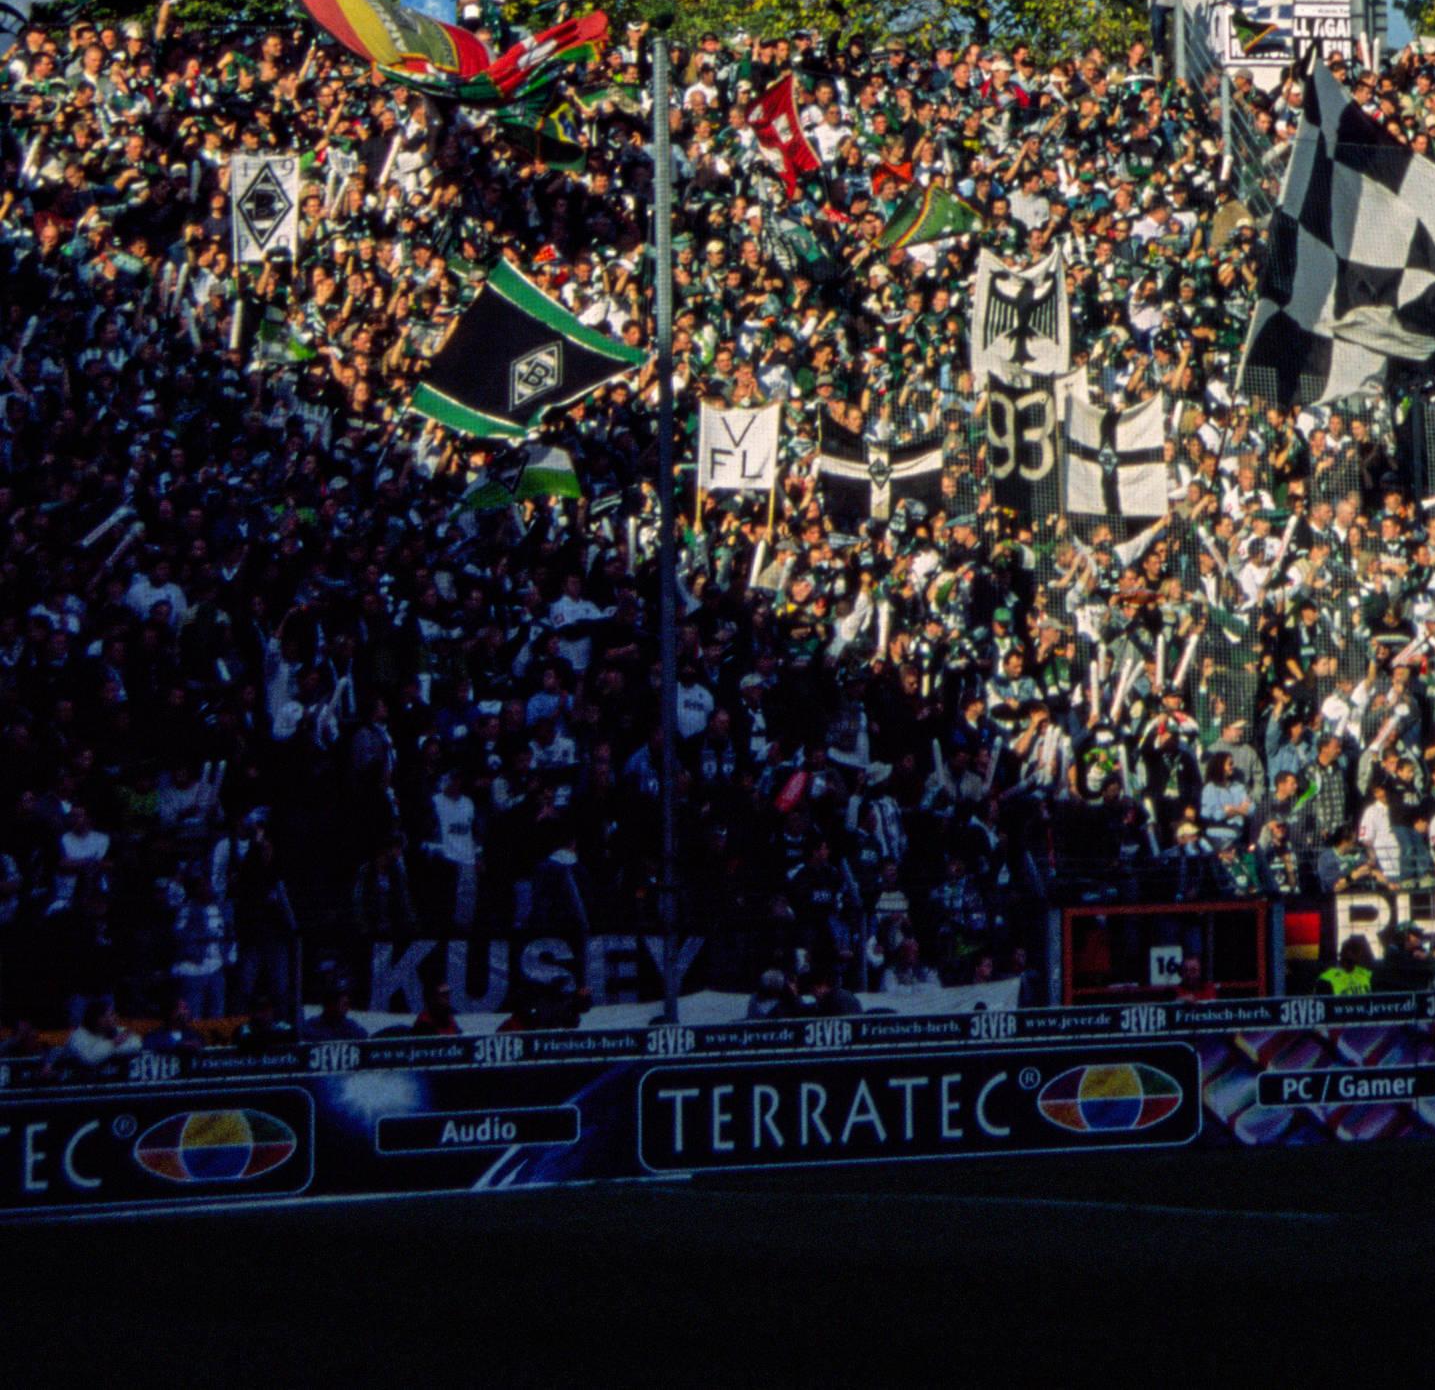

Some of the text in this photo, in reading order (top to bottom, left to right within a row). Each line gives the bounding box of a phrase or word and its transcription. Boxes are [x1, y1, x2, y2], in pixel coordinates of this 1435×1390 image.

[722, 416, 758, 447] V
[710, 448, 767, 481] FL
[372, 934, 705, 1012] KUSEY
[309, 1042, 361, 1071] JEVER
[473, 1033, 525, 1063] JEVER
[647, 1027, 697, 1056] JEVER
[804, 1018, 854, 1048] JEVER
[969, 1010, 1018, 1038] JEVER
[1120, 1006, 1167, 1034] JEVER
[1279, 999, 1326, 1026] JEVER
[1282, 1074, 1315, 1100] PC
[1338, 1071, 1416, 1098] Gamer
[659, 1071, 1010, 1152] TERRATEC
[440, 1117, 517, 1144] Audio
